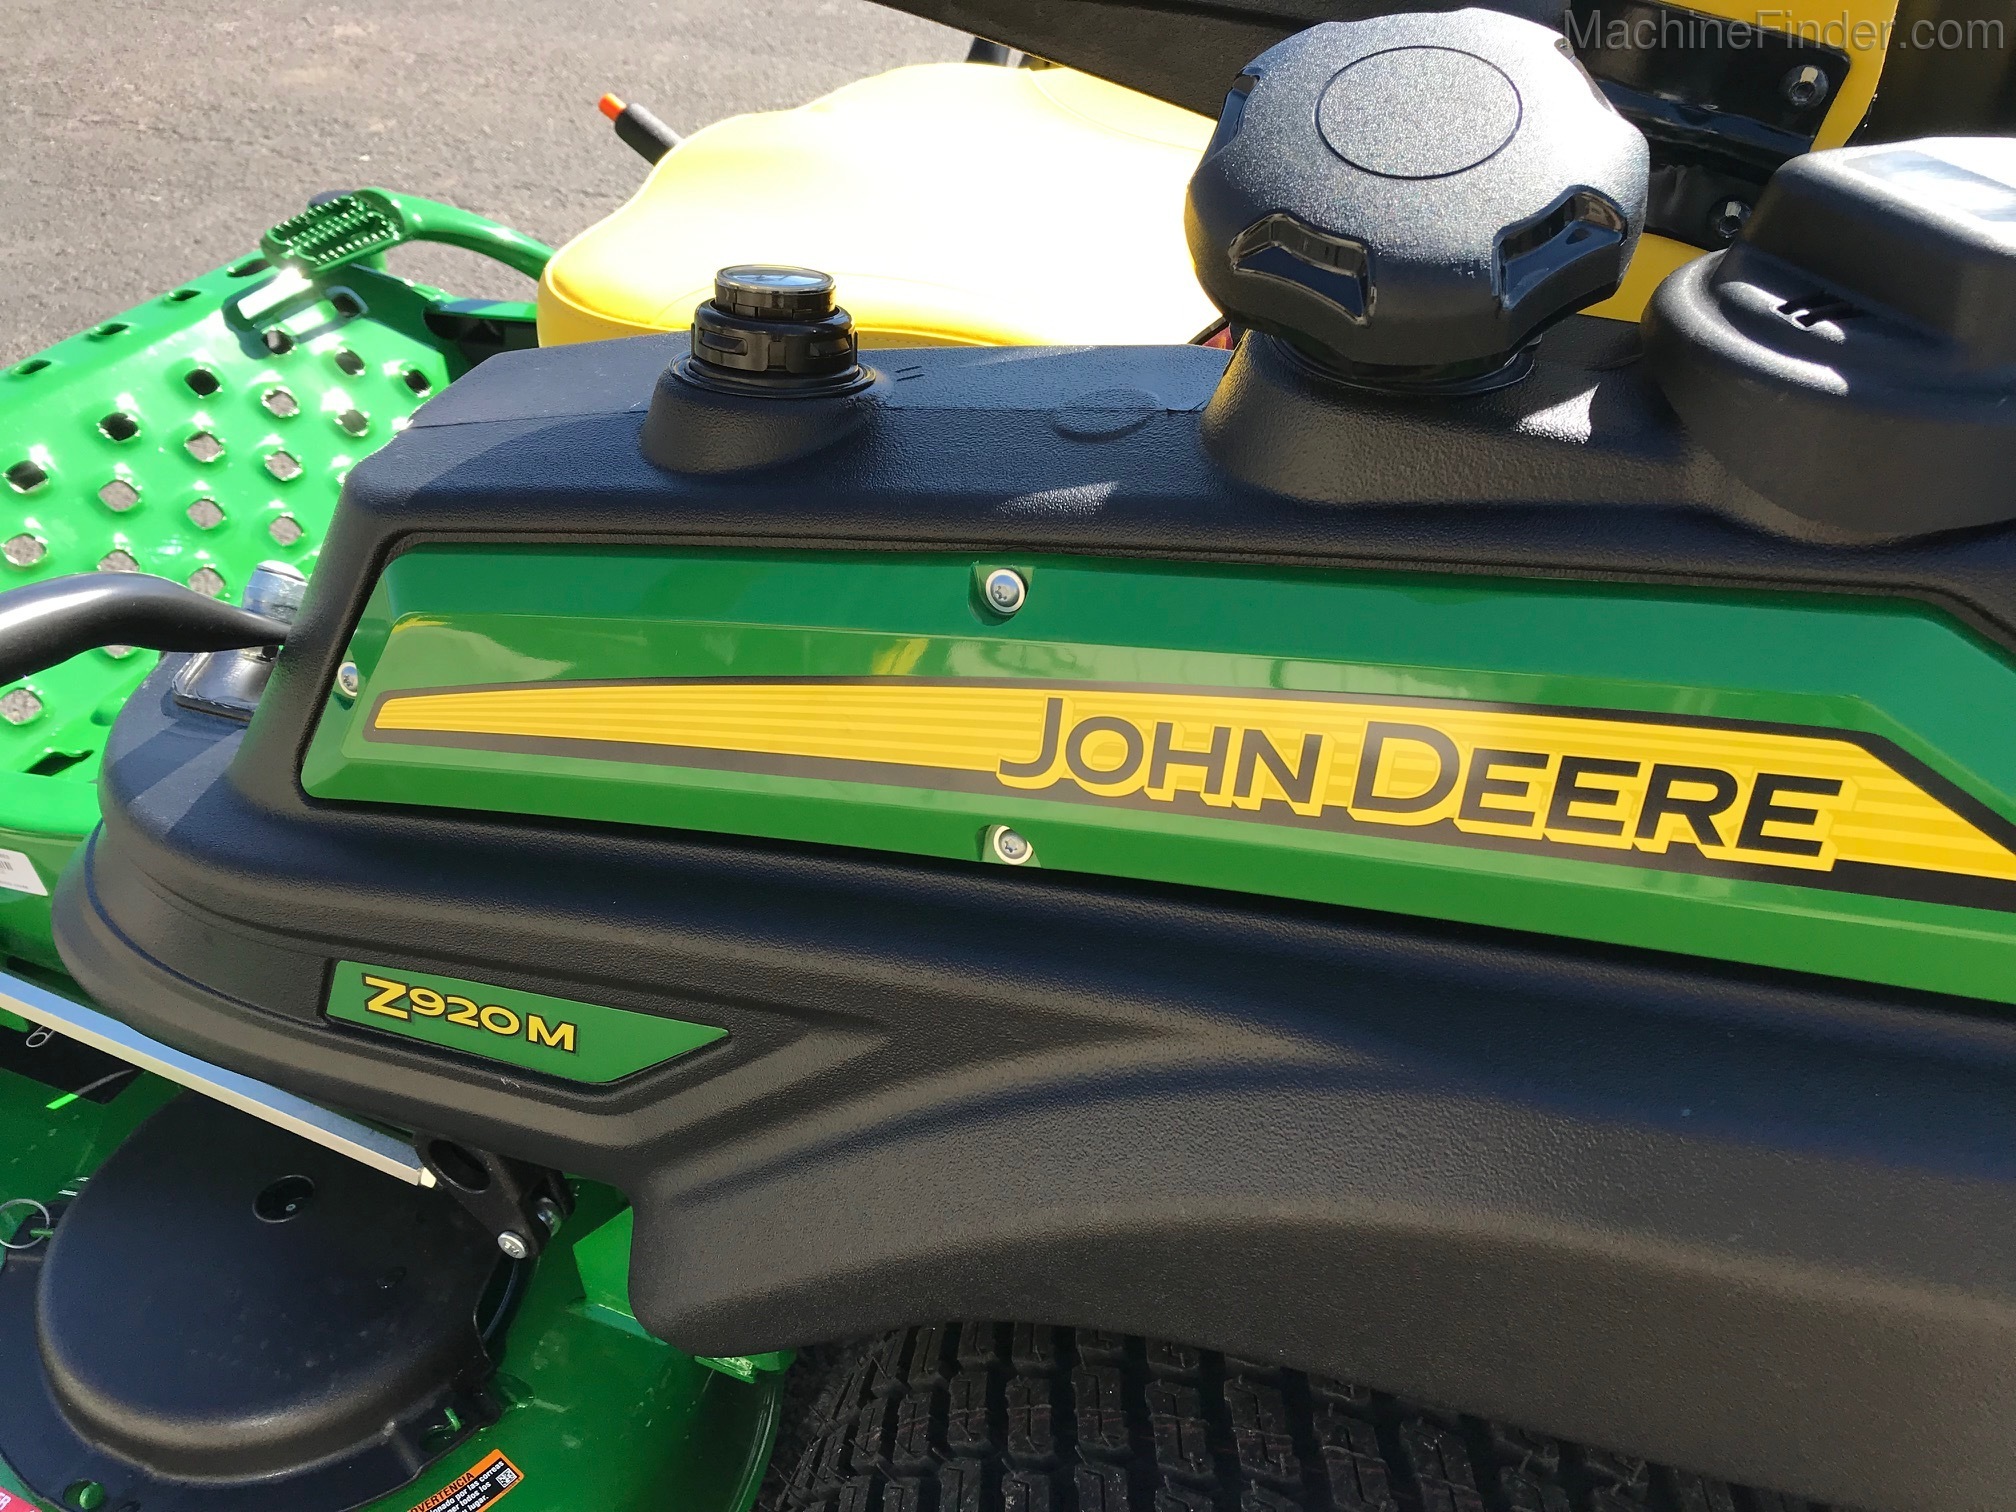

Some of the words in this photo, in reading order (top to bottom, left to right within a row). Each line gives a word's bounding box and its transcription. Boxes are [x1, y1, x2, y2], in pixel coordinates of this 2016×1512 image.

[998, 696, 1324, 808] JOHN
[1360, 721, 1844, 862] DEERE
[455, 1489, 468, 1505] por
[467, 1480, 480, 1491] las
[479, 1461, 504, 1482] correas
[460, 1490, 480, 1506] todos
[480, 1481, 492, 1492] los
[467, 1495, 490, 1511] lugar.
